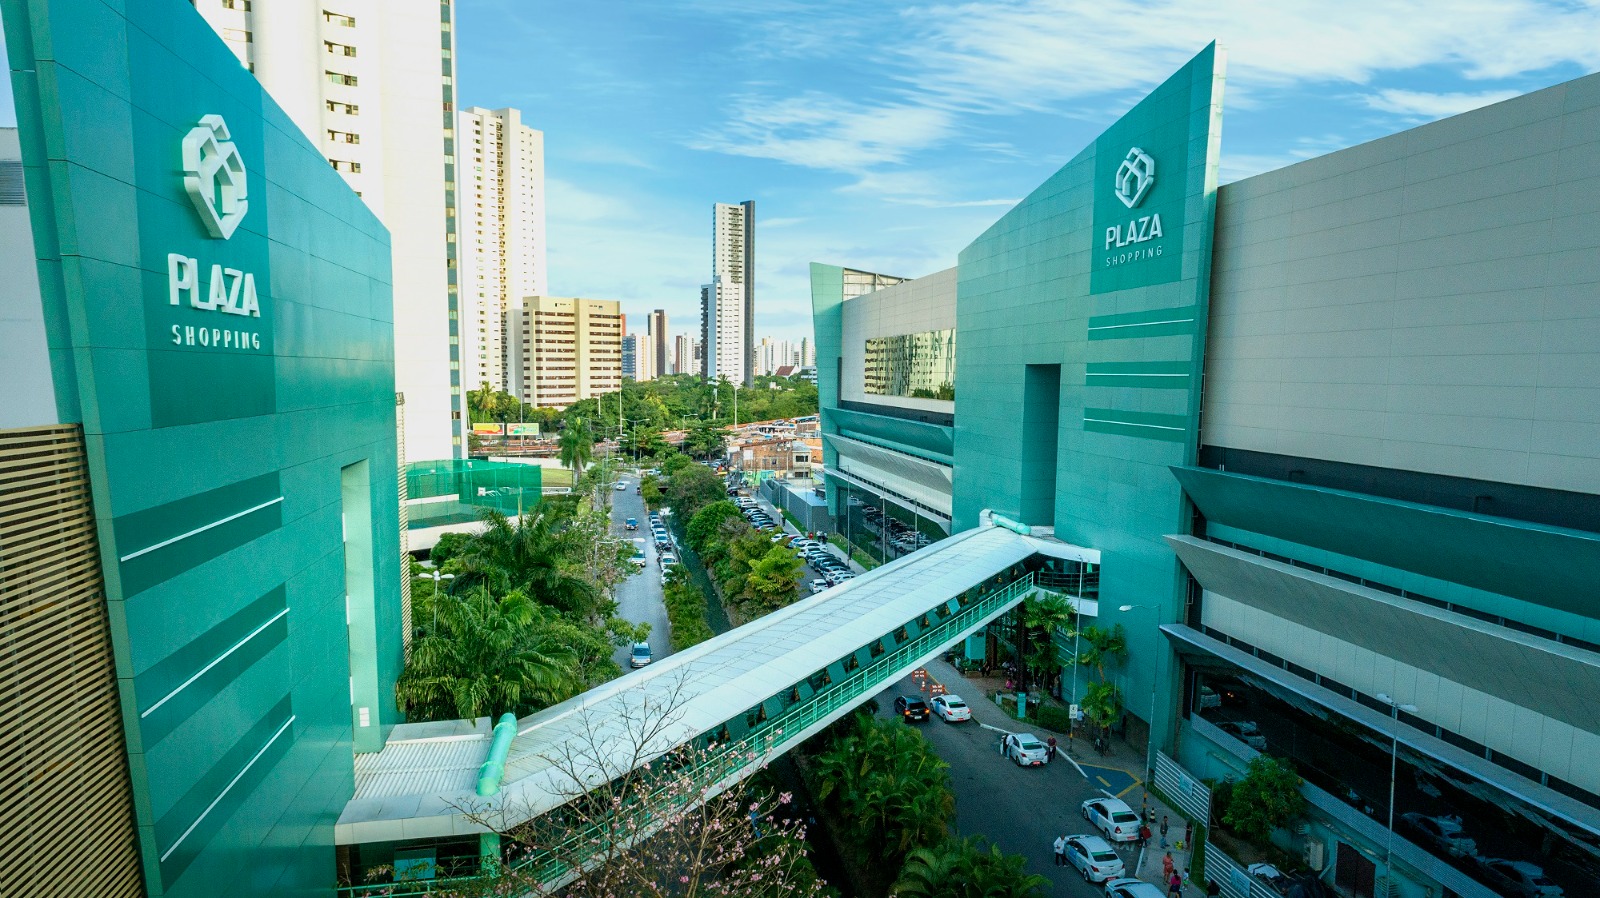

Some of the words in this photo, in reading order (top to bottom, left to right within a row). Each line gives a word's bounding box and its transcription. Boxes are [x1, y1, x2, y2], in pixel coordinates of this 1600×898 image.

[1105, 213, 1163, 250] PLAZA
[1106, 245, 1162, 267] SHOPPING
[168, 253, 261, 318] PLAZA
[172, 324, 260, 350] SHOPPING
